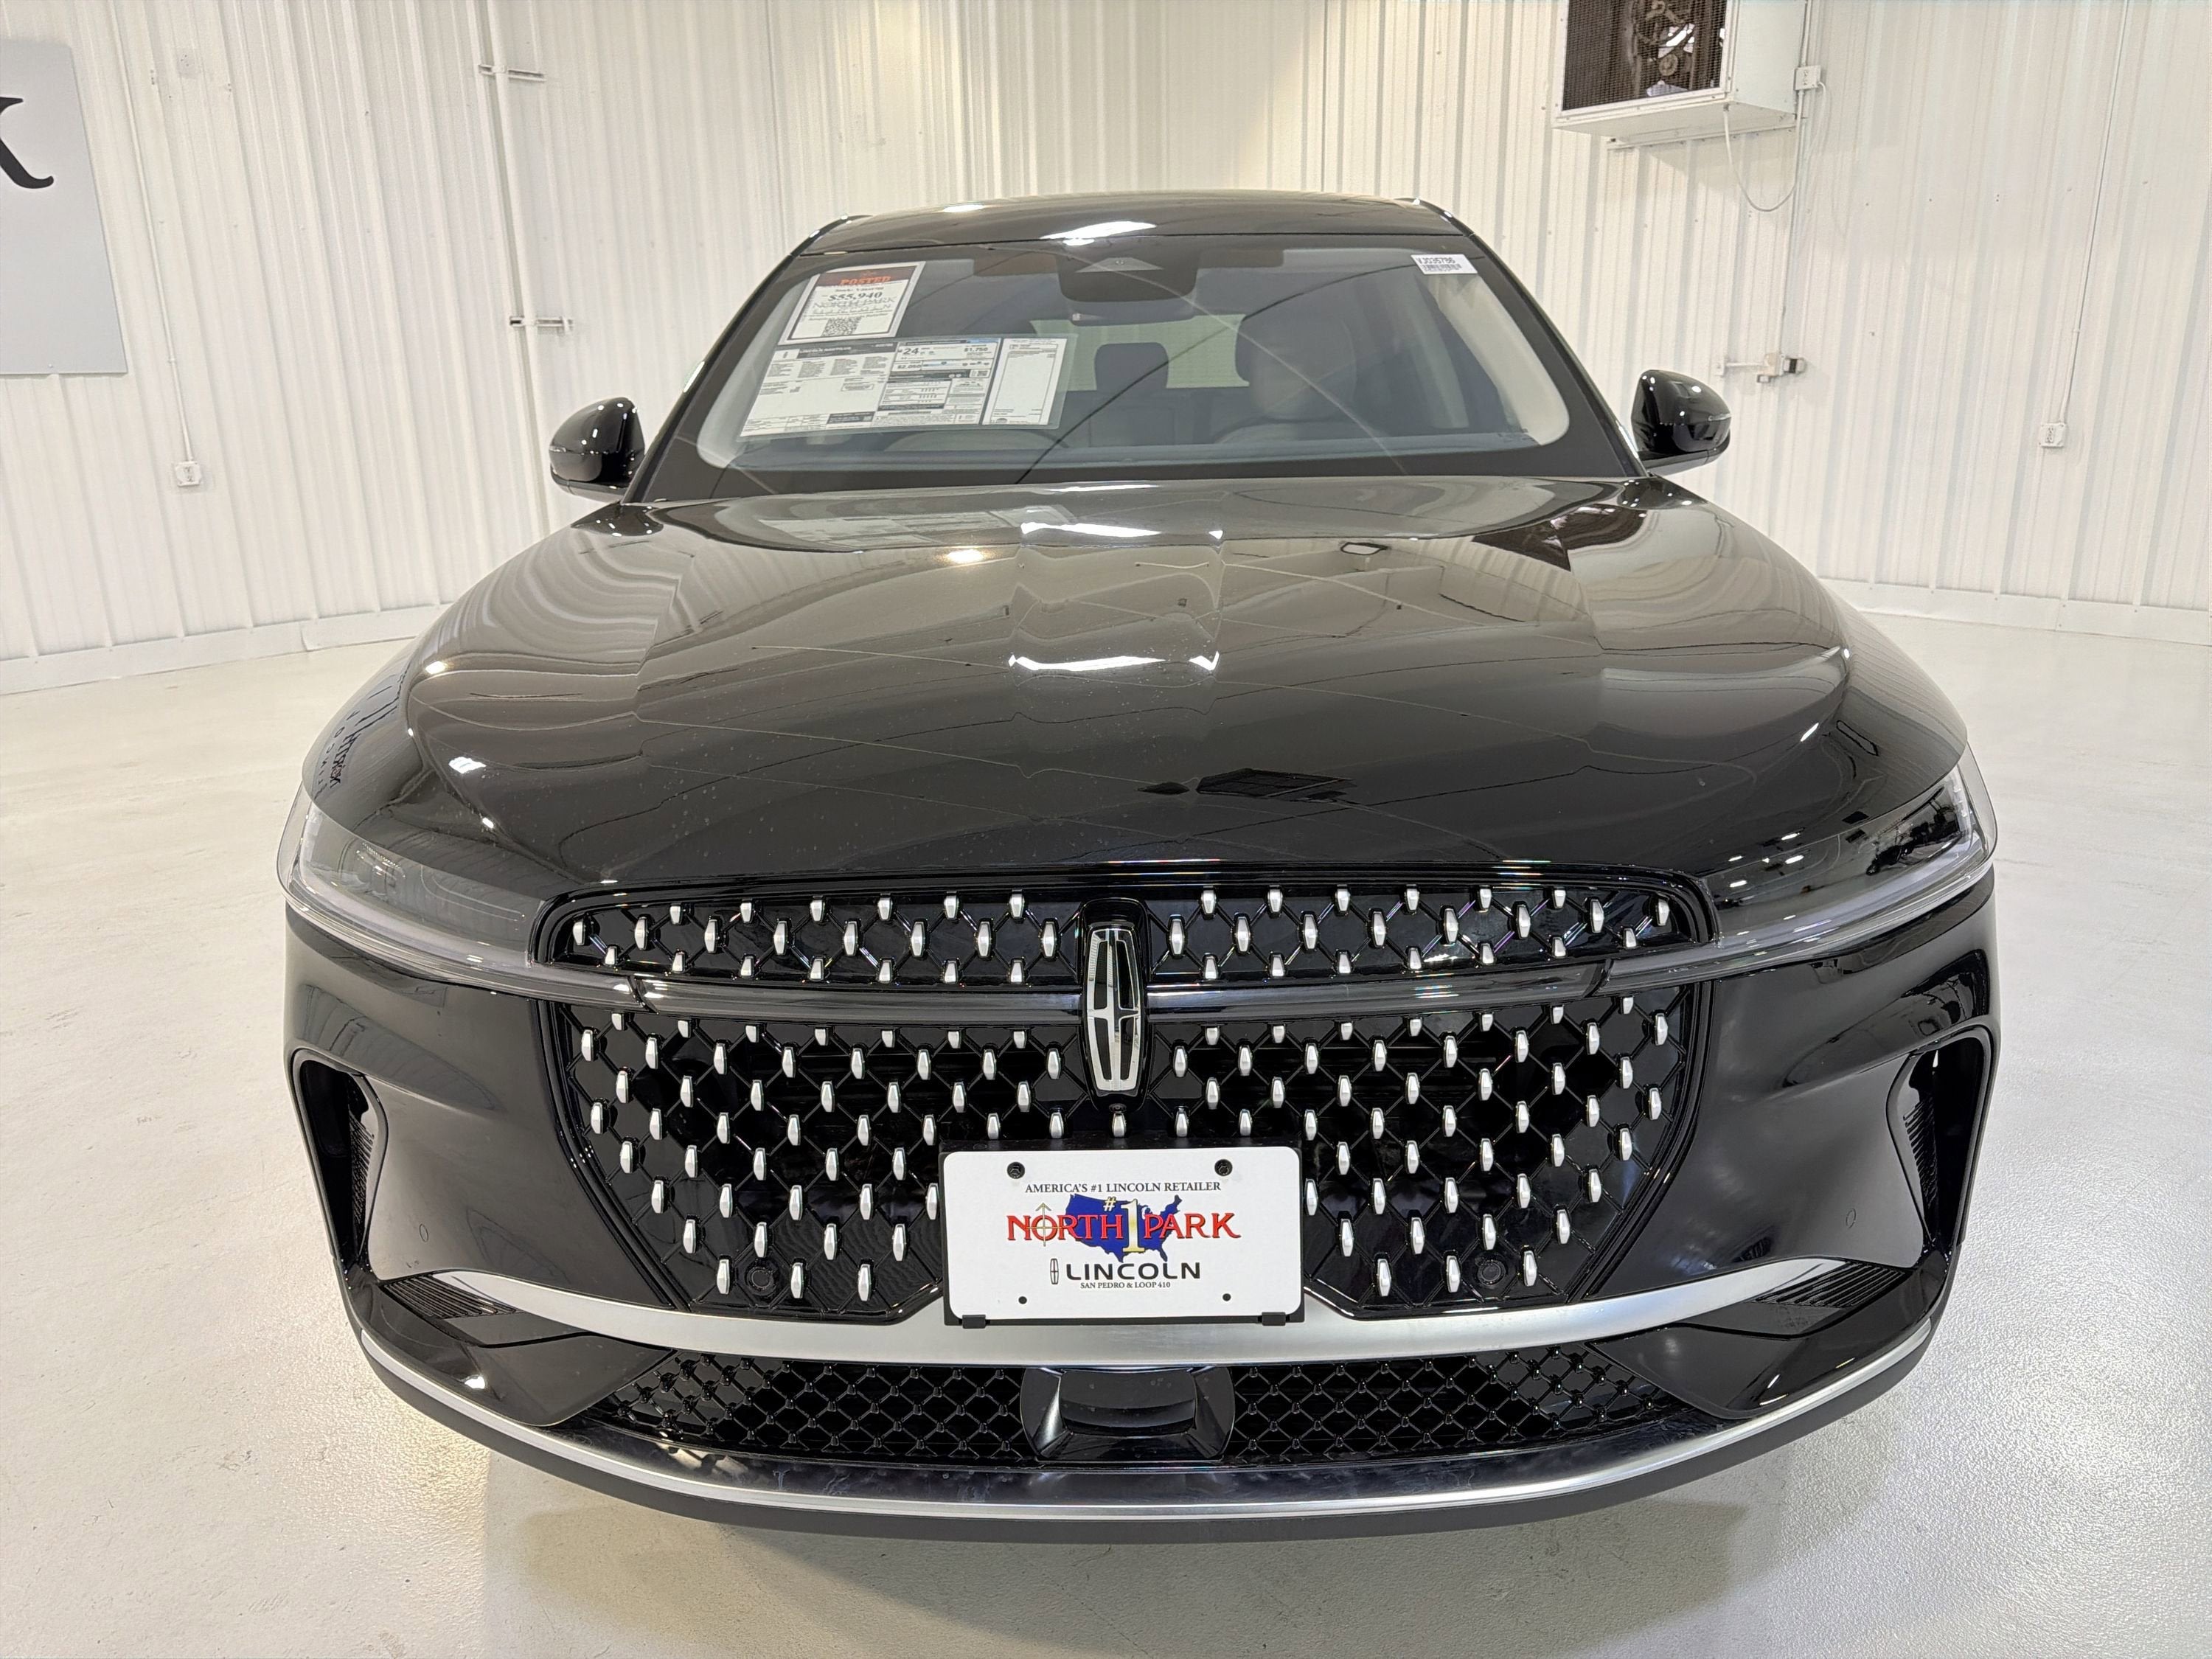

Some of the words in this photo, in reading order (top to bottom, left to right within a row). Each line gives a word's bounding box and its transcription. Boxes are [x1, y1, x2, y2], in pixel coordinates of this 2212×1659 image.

[839, 276, 891, 286] POSTED
[827, 291, 883, 302] $55,940
[1091, 1183, 1104, 1193] #1
[1106, 1183, 1162, 1192] LINCOLN
[1164, 1182, 1221, 1192] RETAILER
[1007, 1214, 1124, 1241] NORTH
[1144, 1212, 1242, 1239] PARK
[1066, 1262, 1200, 1281] LINCOLN
